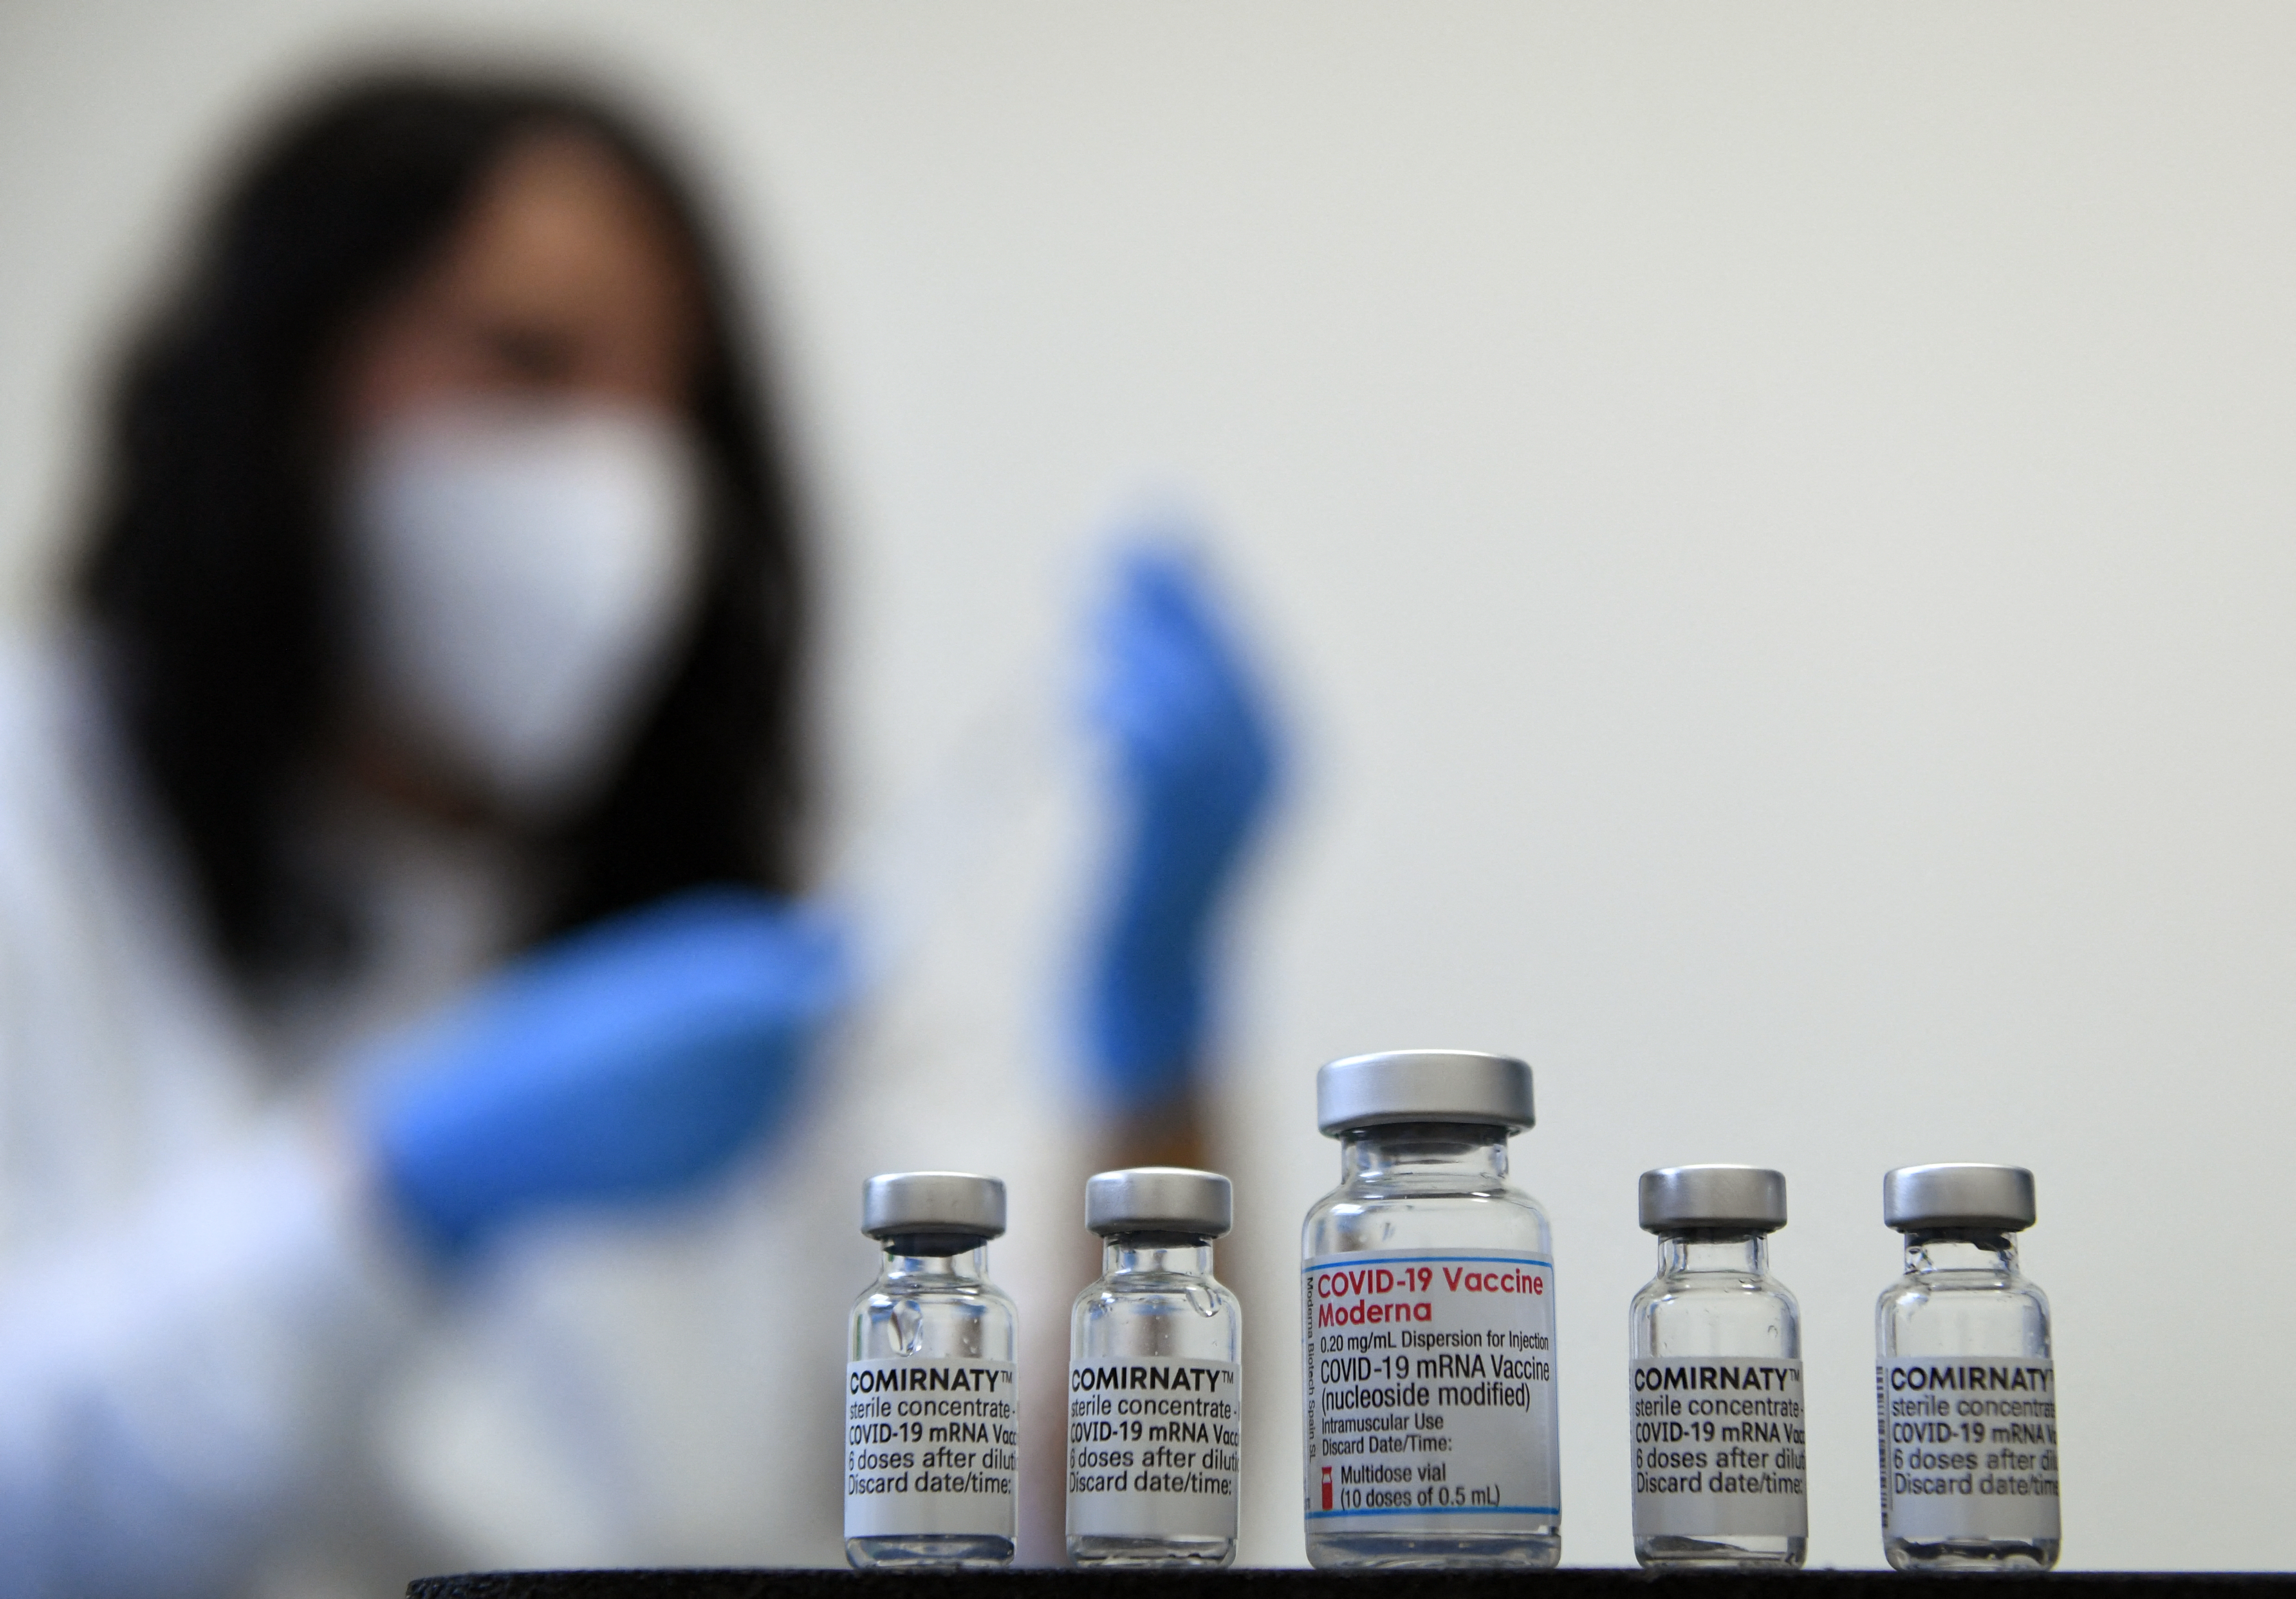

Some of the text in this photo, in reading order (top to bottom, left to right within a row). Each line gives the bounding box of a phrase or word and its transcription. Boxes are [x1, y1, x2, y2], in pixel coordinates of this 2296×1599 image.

[1317, 1266, 1544, 1299] COVID-19 Vaccine
[1318, 1299, 1433, 1329] Moderna
[1320, 1330, 1550, 1354] 0.20 mg/mL Dispersion for Injection
[1320, 1354, 1550, 1384] COVID-19 mRNA Vaccine
[850, 1396, 892, 1420] sterile
[897, 1398, 1010, 1419] concentrate
[1071, 1394, 1112, 1417] sterile
[1117, 1397, 1231, 1419] concentrate
[1321, 1382, 1531, 1417] (nucleoside modified)
[1635, 1394, 1682, 1418] sterile
[1688, 1397, 1799, 1418] concentrate
[1892, 1394, 1950, 1418] sterile
[849, 1422, 923, 1446] COVID-19
[928, 1422, 989, 1444] mRNA
[1070, 1420, 1143, 1444] COVID-19
[1149, 1421, 1209, 1444] mRNA
[1321, 1412, 1444, 1435] Intramuscular Use
[1635, 1421, 1715, 1443] COVID-19
[1721, 1421, 1781, 1443] mRNA
[1893, 1422, 1986, 1444] COVID-19
[1992, 1422, 2045, 1444] mRNA
[1069, 1448, 1075, 1469] 6
[1078, 1446, 1134, 1469] doses
[1142, 1446, 1196, 1468] after
[1309, 1444, 1316, 1464] SL
[1322, 1434, 1453, 1457] Discard Date/Time:
[848, 1450, 855, 1471] 6
[857, 1448, 915, 1470] doses
[922, 1445, 977, 1469] after
[1636, 1448, 1643, 1469] 6
[1647, 1447, 1708, 1470] doses
[1715, 1446, 1770, 1469] after
[1893, 1447, 1904, 1470] 6
[1909, 1448, 1978, 1470] doses
[1986, 1447, 2036, 1470] after
[848, 1470, 1011, 1495] Discard date/time:
[1069, 1470, 1232, 1496] Discard date/time:
[1340, 1462, 1446, 1486] Multidose vial
[1637, 1471, 1803, 1495] Discard date/time:
[1895, 1472, 1973, 1496] Discard
[1340, 1484, 1501, 1511] (10 doses of 0.5 mL)
